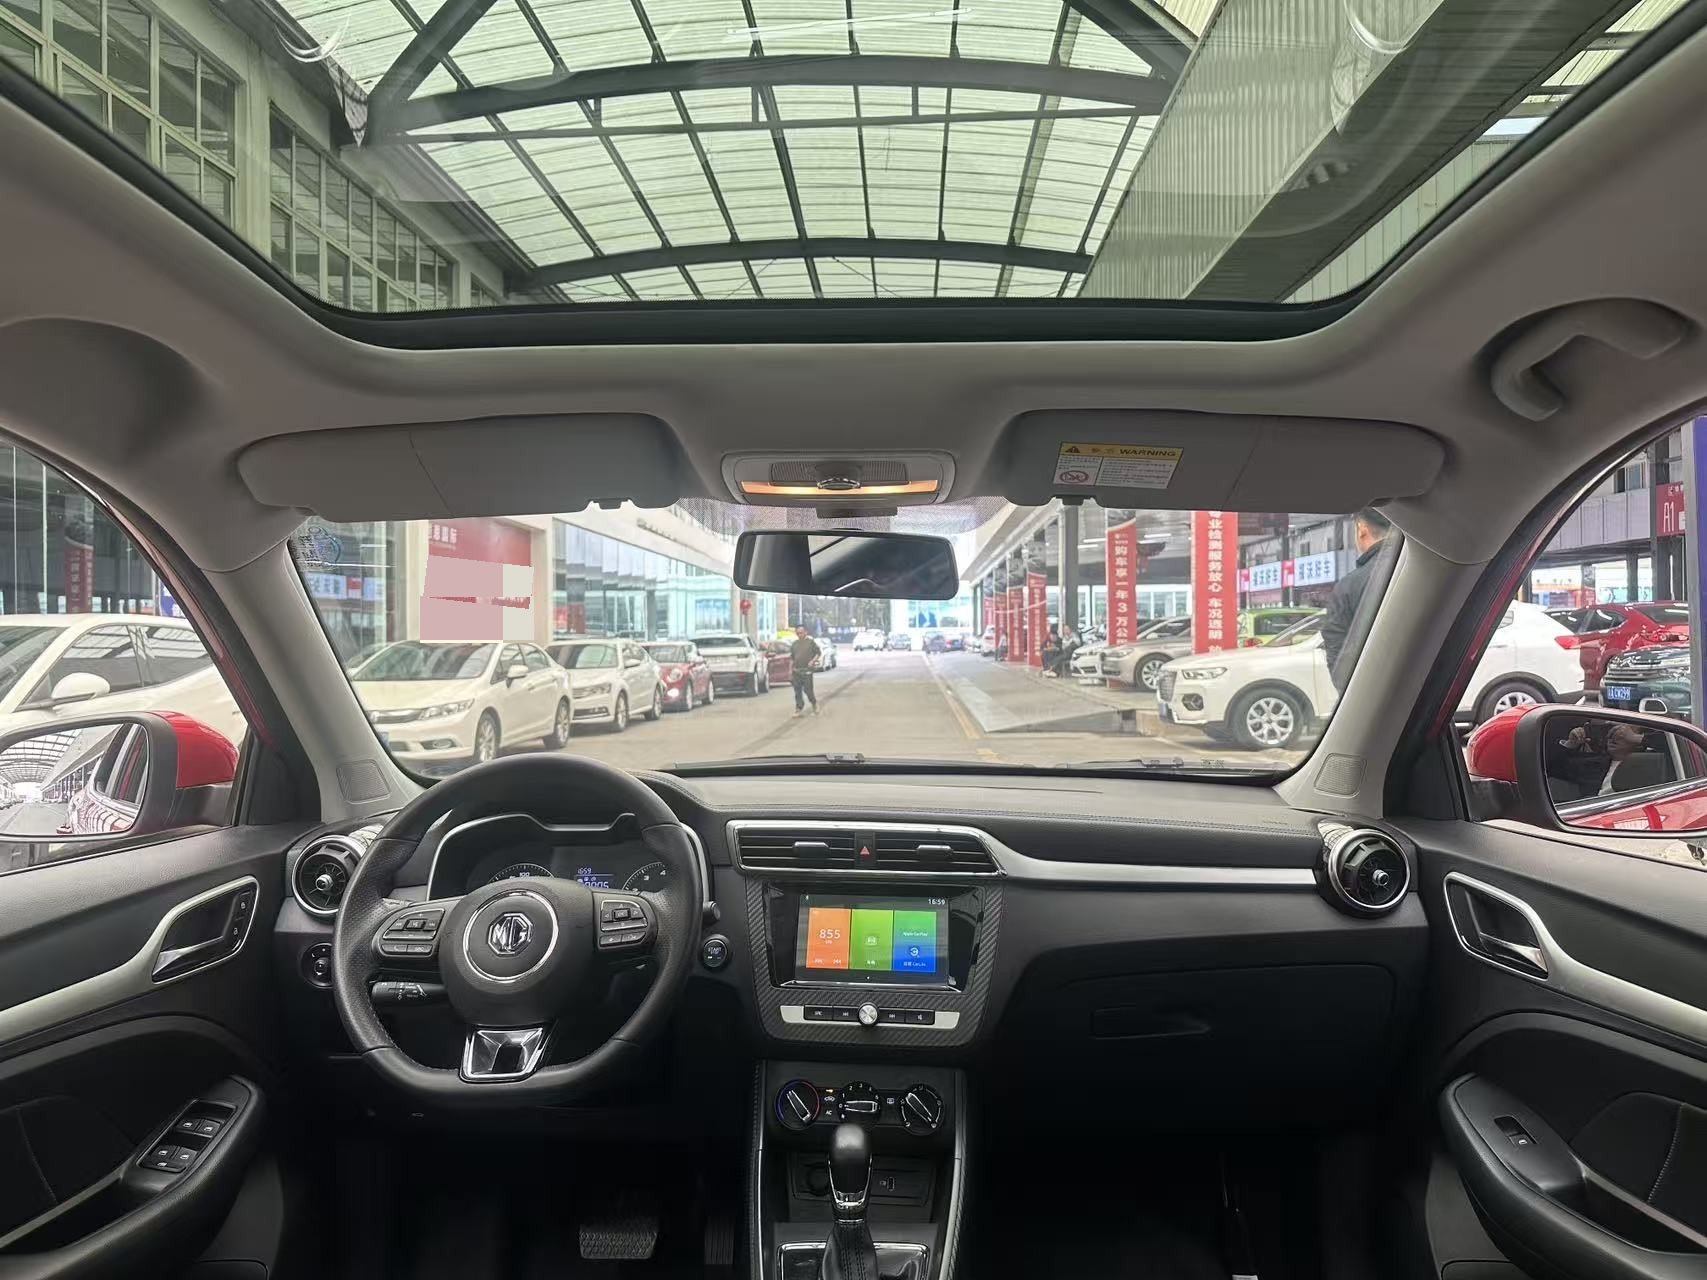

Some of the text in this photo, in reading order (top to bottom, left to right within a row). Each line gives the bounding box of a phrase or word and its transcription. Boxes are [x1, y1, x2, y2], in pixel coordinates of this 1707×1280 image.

[1119, 448, 1176, 457] WARNING
[1663, 501, 1675, 533] A1
[492, 914, 532, 950] MG
[818, 928, 841, 939] 855
